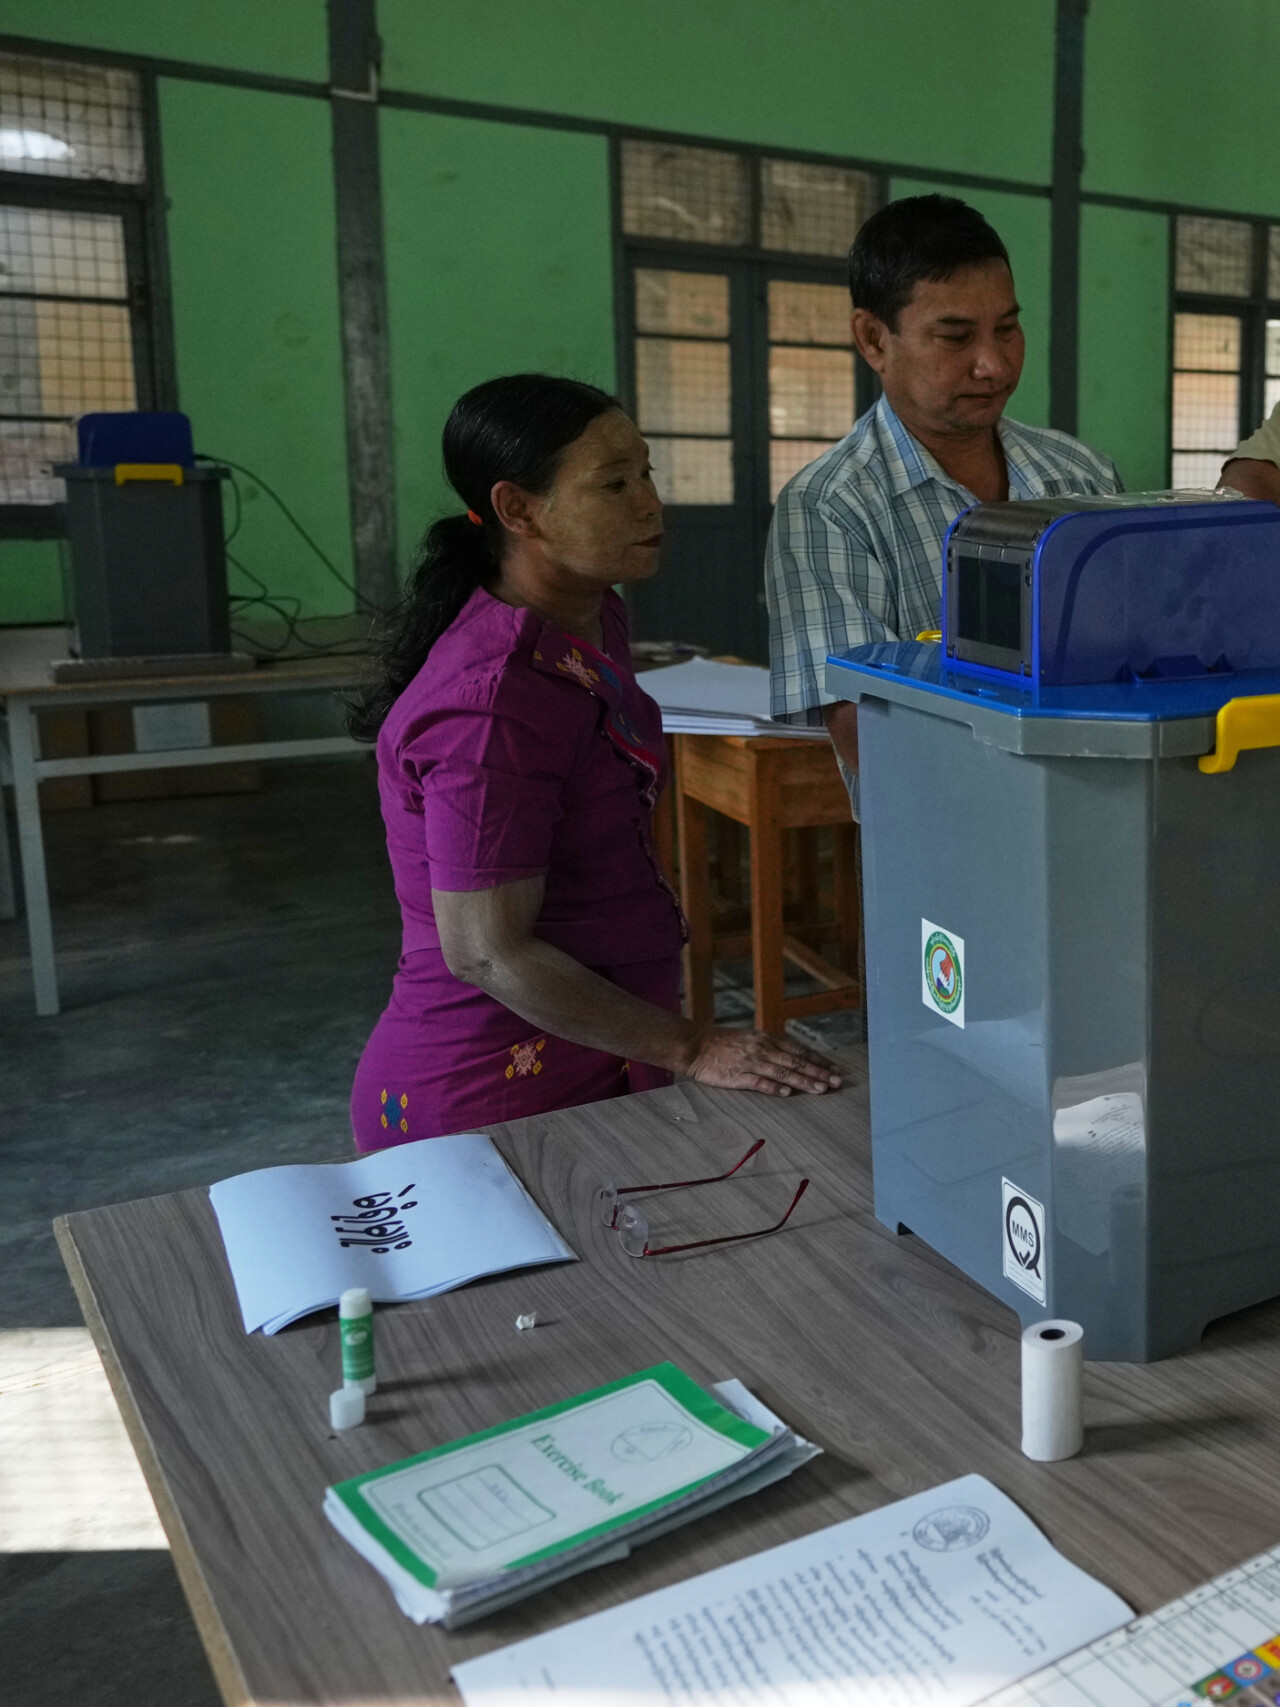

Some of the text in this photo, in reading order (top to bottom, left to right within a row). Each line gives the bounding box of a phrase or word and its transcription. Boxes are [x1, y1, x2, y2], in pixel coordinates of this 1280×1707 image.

[1012, 1220, 1034, 1248] MMS
[530, 1433, 589, 1483] Exercise
[582, 1478, 625, 1506] Book
